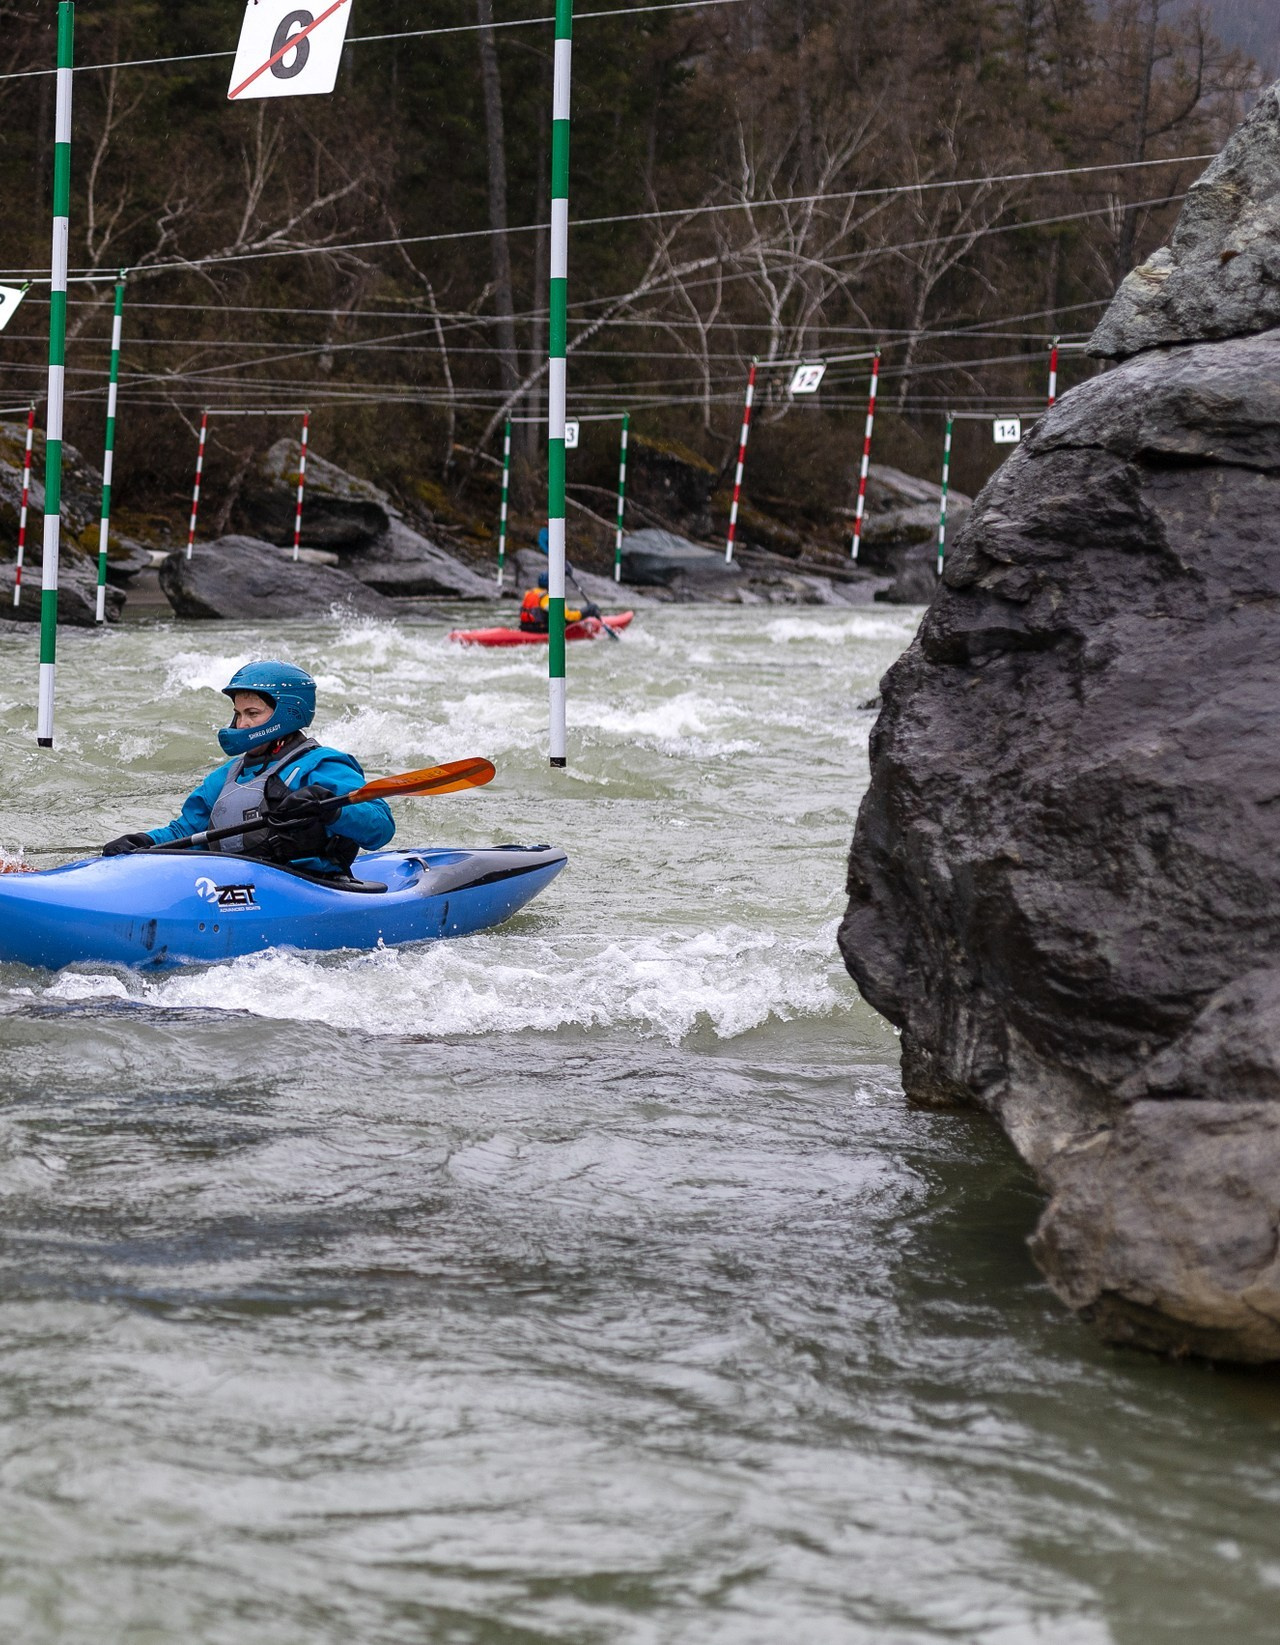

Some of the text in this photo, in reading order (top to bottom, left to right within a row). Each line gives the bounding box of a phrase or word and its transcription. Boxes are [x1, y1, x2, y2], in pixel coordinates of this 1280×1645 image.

[269, 9, 314, 79] 6
[799, 371, 819, 387] 12
[566, 427, 575, 442] 3
[1000, 425, 1016, 437] 14
[248, 723, 282, 740] SHRED READY
[214, 884, 257, 906] ZET
